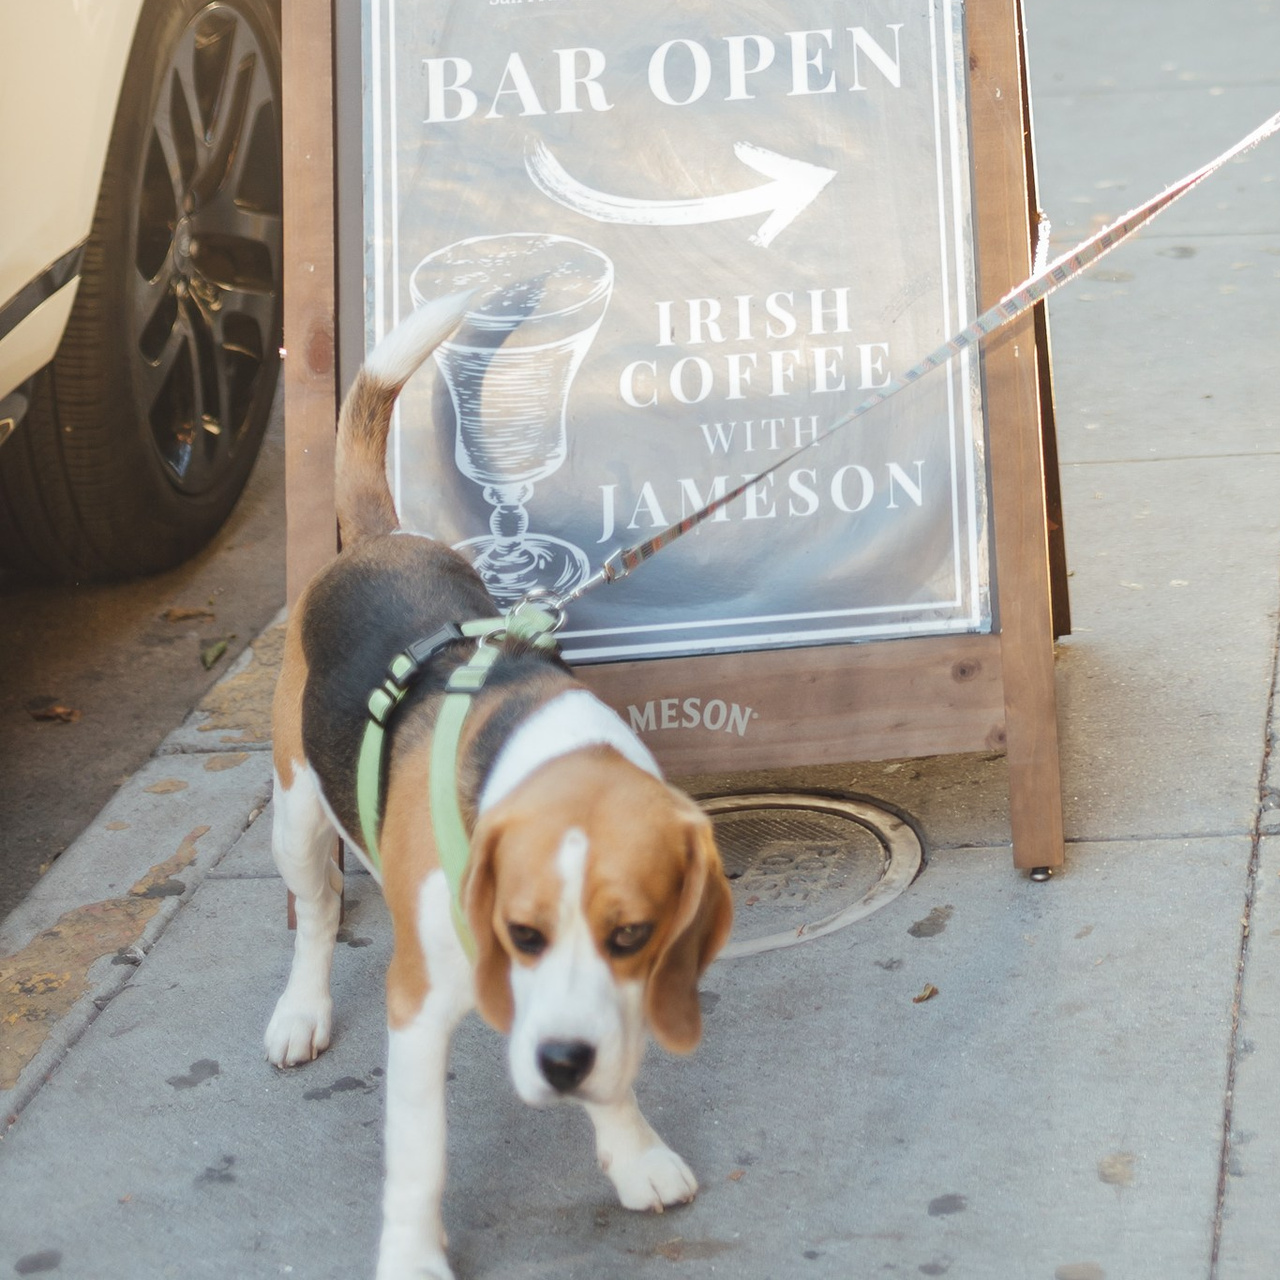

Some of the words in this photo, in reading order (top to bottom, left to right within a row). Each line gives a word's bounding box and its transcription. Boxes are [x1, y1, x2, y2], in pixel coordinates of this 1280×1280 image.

[421, 46, 615, 124] BAR
[648, 23, 905, 106] OPEN
[655, 287, 853, 347] IRISH
[619, 342, 893, 407] COFFEE
[700, 415, 820, 455] WITH
[597, 460, 925, 544] JAMESON
[627, 697, 754, 737] MESON
